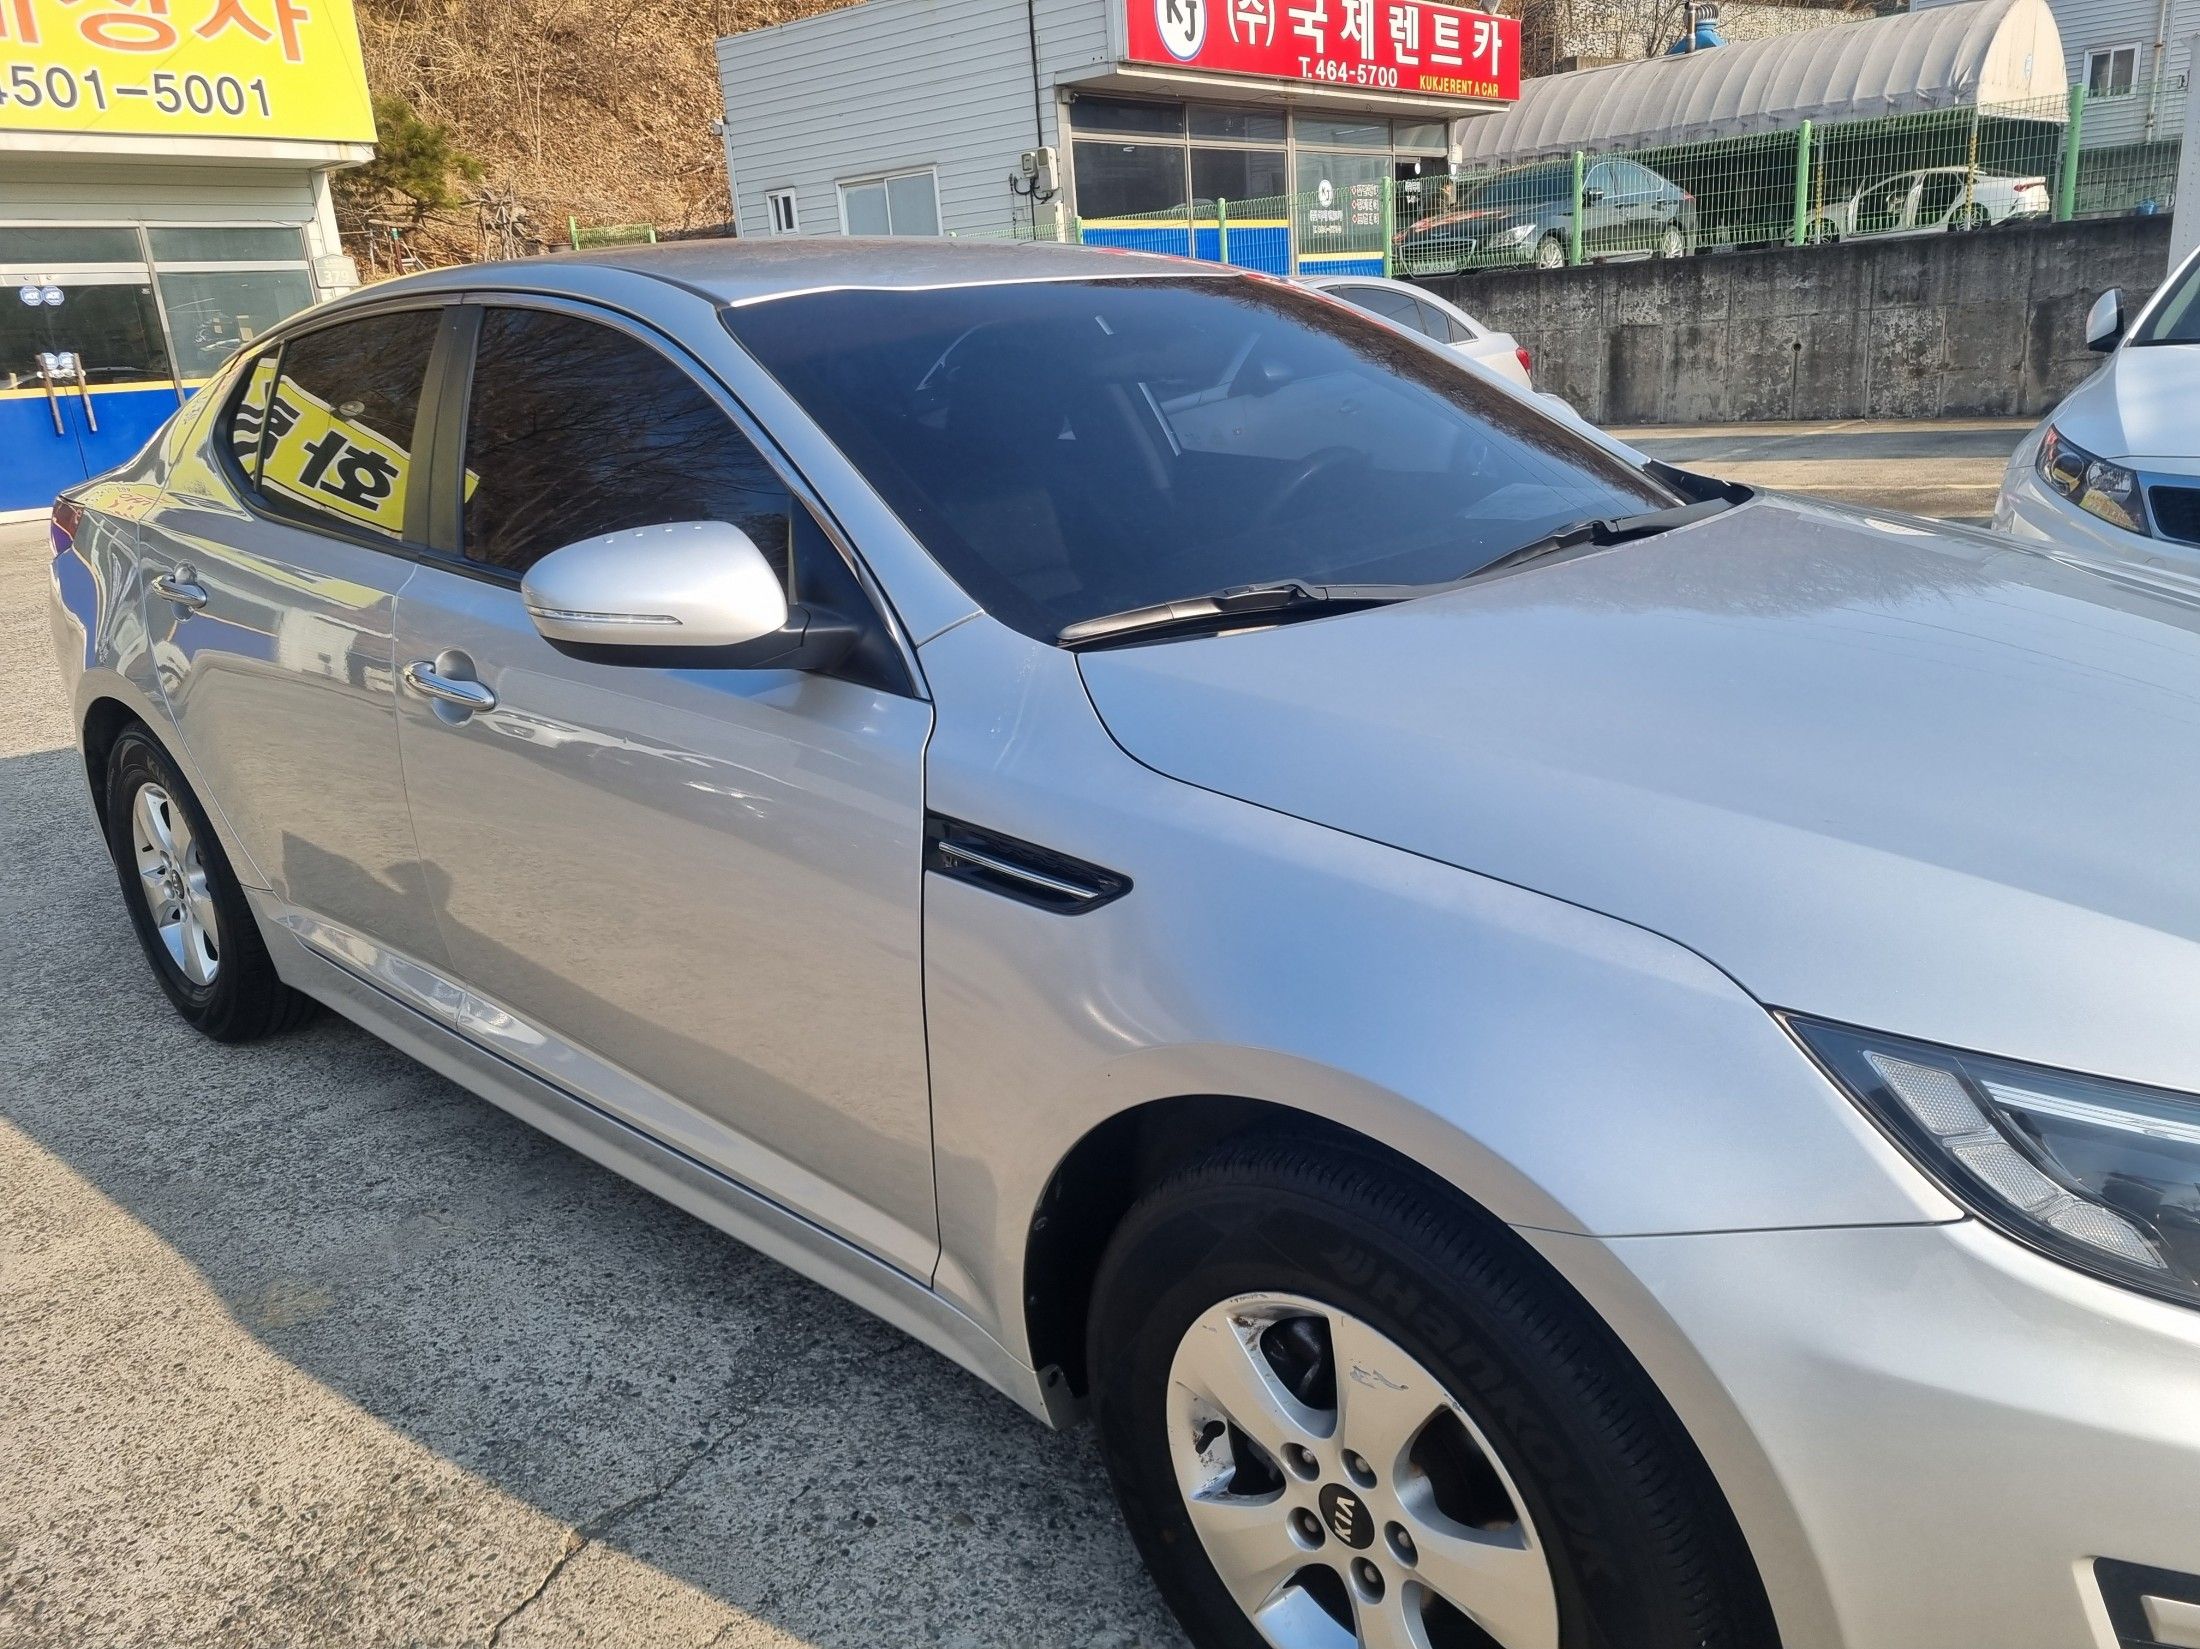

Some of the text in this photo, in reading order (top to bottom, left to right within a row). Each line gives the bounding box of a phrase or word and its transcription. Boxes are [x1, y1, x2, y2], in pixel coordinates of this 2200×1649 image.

[0, 65, 269, 117] 501-5001
[1481, 82, 1499, 97] CAR
[1334, 1496, 1356, 1543] KIA
